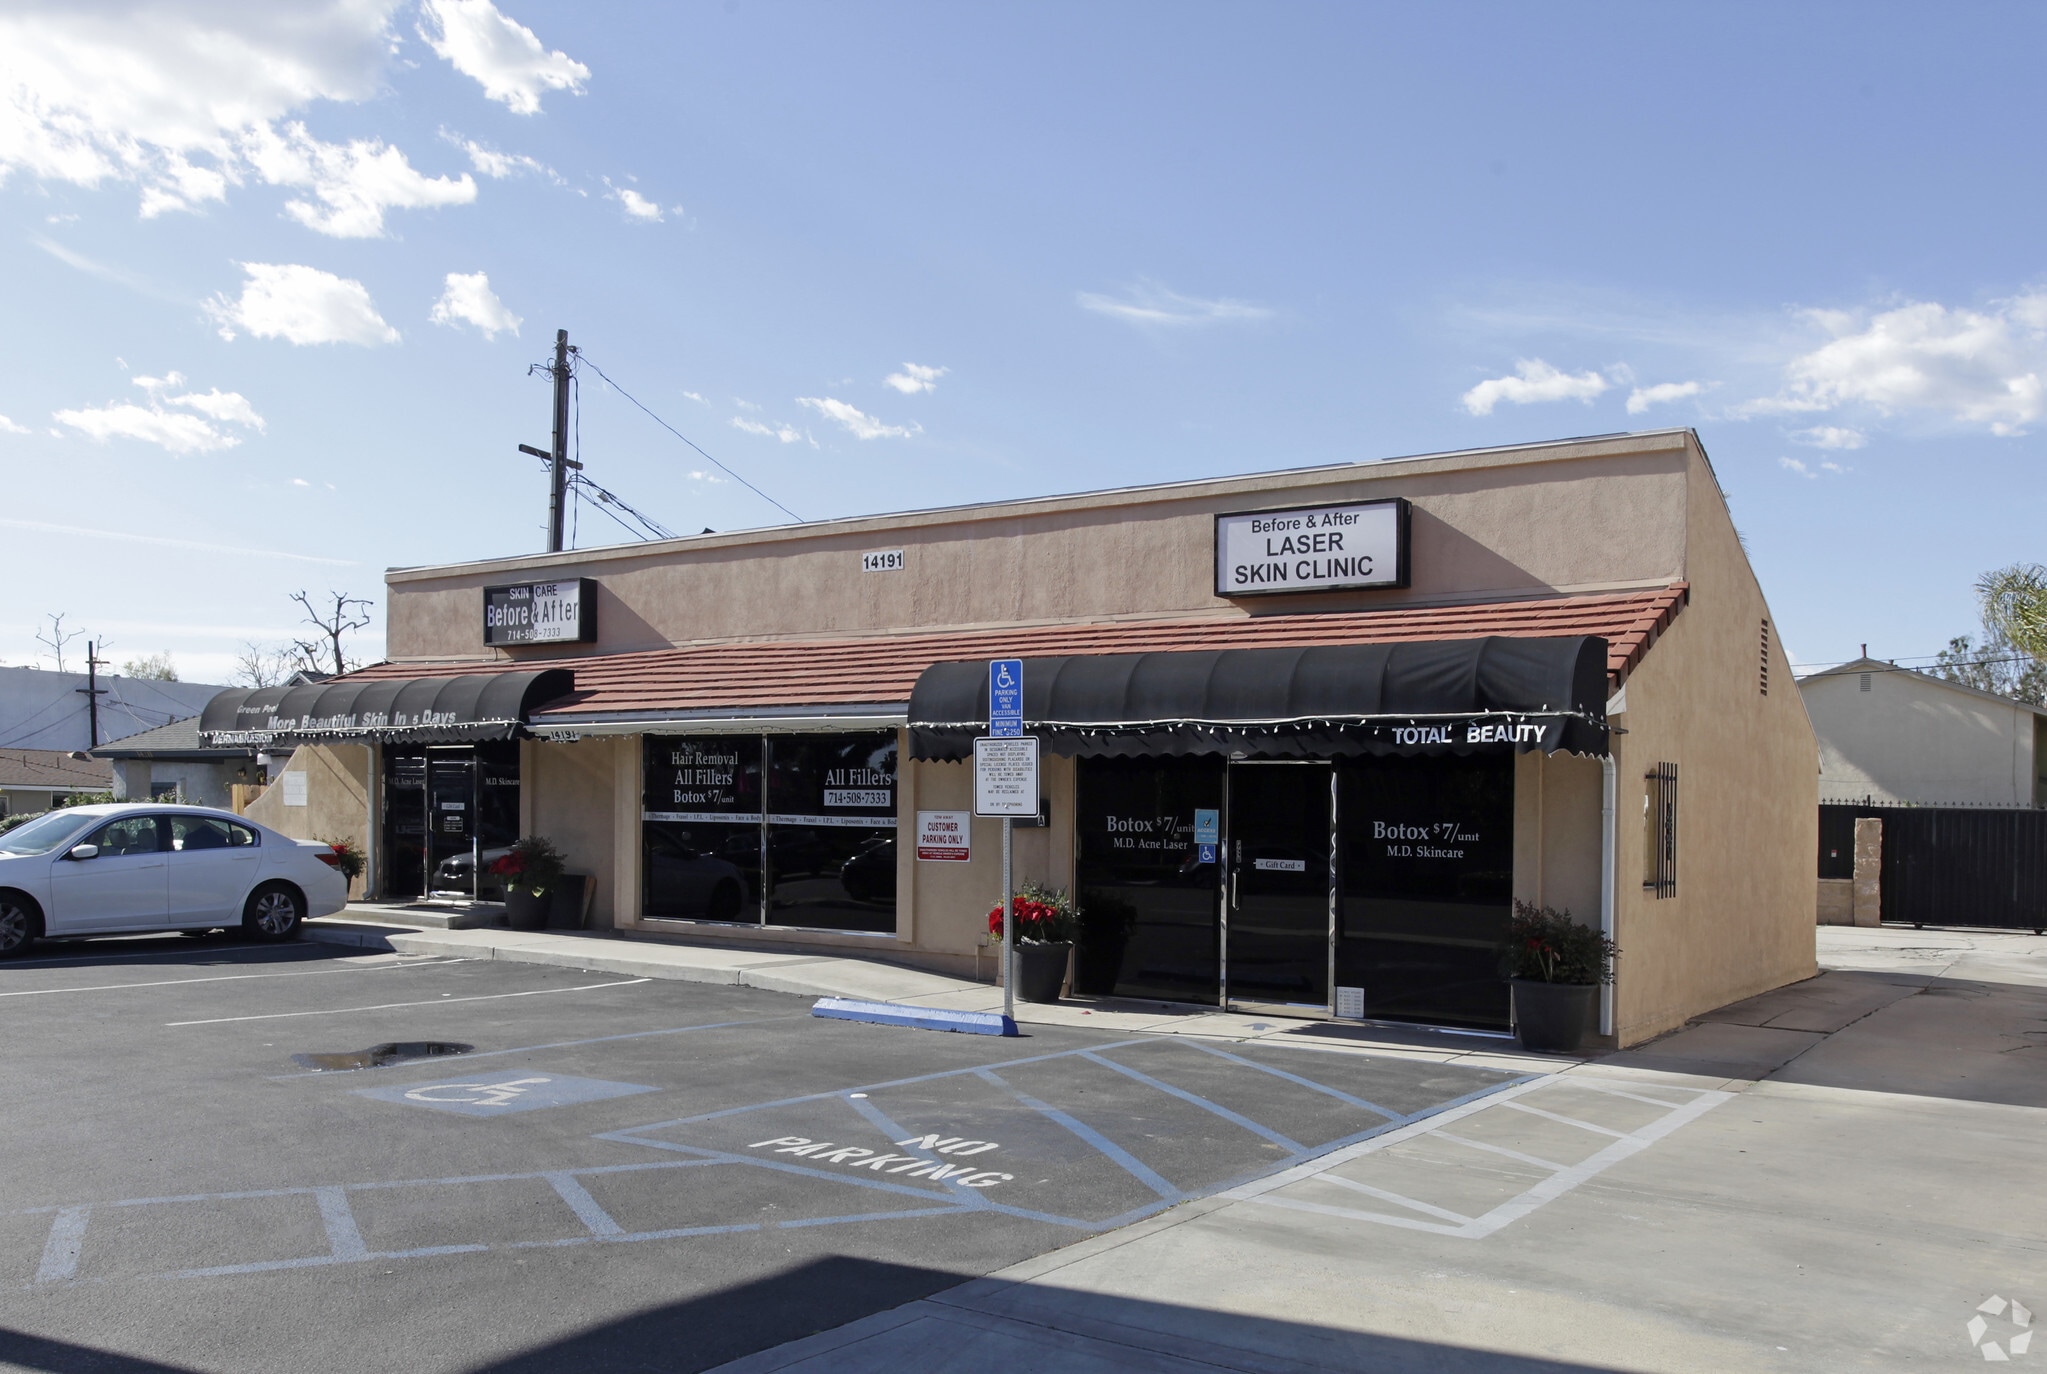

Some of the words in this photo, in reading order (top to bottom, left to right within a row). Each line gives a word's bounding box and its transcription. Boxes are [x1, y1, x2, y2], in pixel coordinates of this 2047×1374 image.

[1251, 518, 1301, 534] Before
[1306, 514, 1317, 528] &
[1321, 512, 1360, 528] After
[1266, 532, 1344, 556] LASER
[864, 552, 902, 570] 14191
[1234, 562, 1288, 584] SKIN
[1295, 556, 1374, 580] CLINIC
[509, 587, 530, 600] SKIN
[535, 584, 558, 598] CARE
[487, 604, 528, 627] Before
[530, 602, 539, 624] &
[542, 600, 578, 623] After
[508, 628, 560, 640] 714-508-7333
[999, 696, 1012, 704] ONLY
[236, 705, 260, 714] Green
[267, 716, 296, 730] More
[301, 713, 357, 729] Beautiful
[362, 712, 388, 726] Skin
[394, 711, 406, 726] In
[412, 714, 418, 725] 5
[422, 709, 456, 724] Days
[1392, 727, 1452, 744] TOTAL
[1466, 725, 1547, 743] BEAUTY
[672, 752, 694, 764] Hair
[696, 752, 738, 765] Removal
[498, 778, 520, 786] Skincare
[675, 769, 692, 784] All
[696, 770, 733, 785] Fillers
[825, 768, 845, 786] All
[849, 768, 892, 786] Fillers
[674, 790, 706, 803] Botox
[708, 790, 734, 804] $7/unit
[928, 822, 958, 832] CUSTOMER
[1106, 816, 1153, 832] Botox
[1156, 816, 1195, 835] $7/unit
[1373, 821, 1430, 840] Botox
[1433, 822, 1480, 844] $7/unit
[922, 834, 946, 844] PARKING
[948, 834, 964, 844] ONLY
[1114, 838, 1134, 848] M.D.
[1138, 838, 1160, 848] Acne
[1164, 839, 1188, 850] Laser
[1387, 845, 1412, 856] M.D.
[1416, 846, 1464, 858] Skincare
[895, 1133, 999, 1156] NO
[747, 1136, 1014, 1188] PARKING
